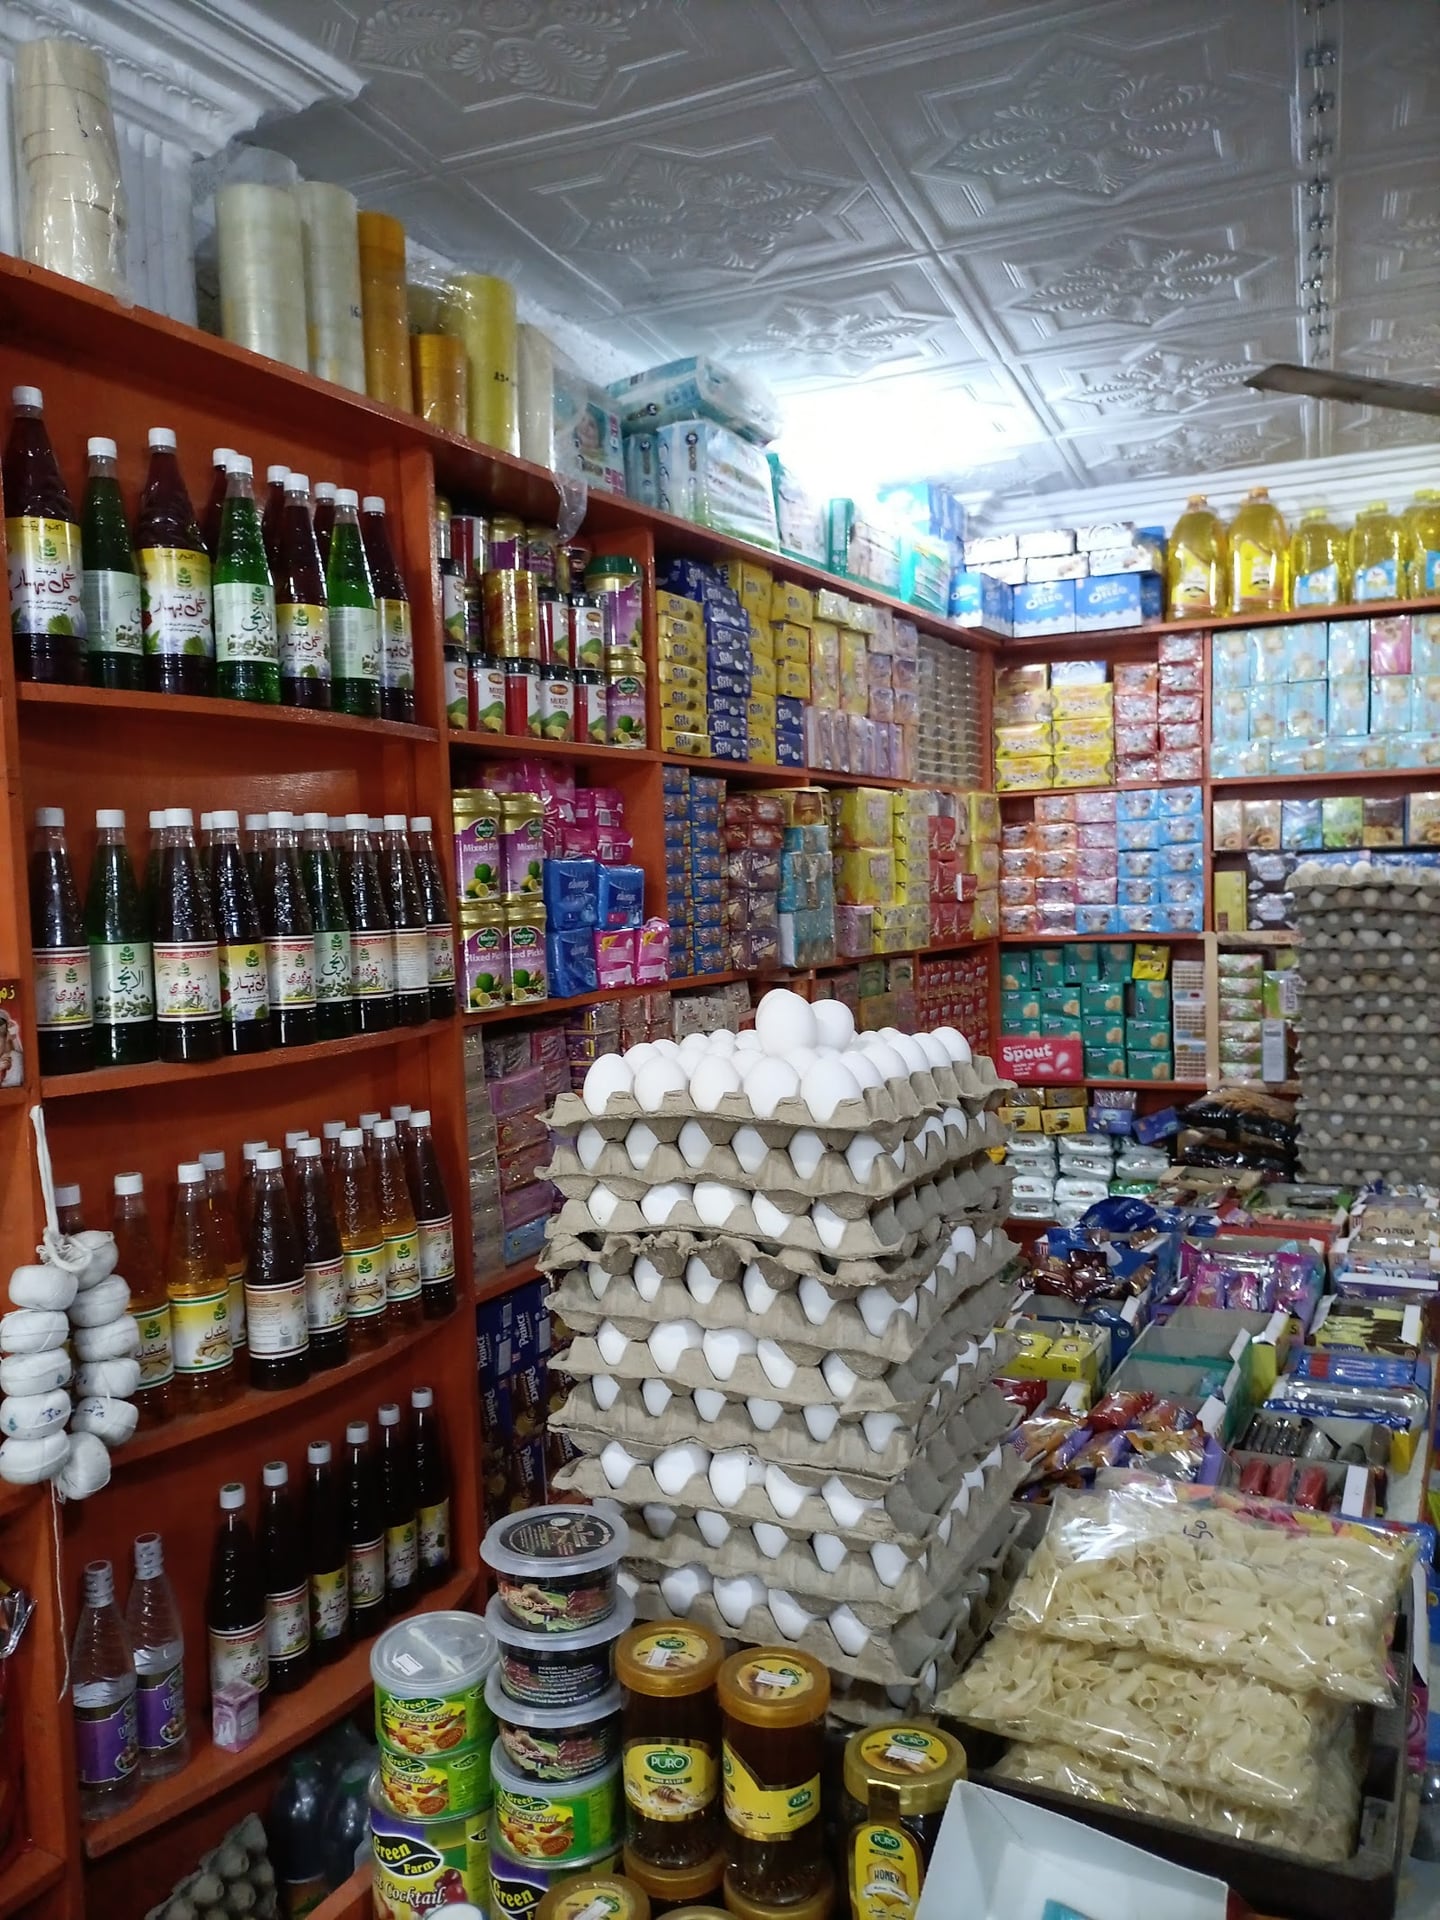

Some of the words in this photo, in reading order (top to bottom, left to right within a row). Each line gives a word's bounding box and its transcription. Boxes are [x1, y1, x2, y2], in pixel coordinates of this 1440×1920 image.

[15, 568, 46, 595] بہار
[48, 565, 76, 594] گل
[184, 592, 207, 617] گل
[463, 844, 487, 853] Mixed
[107, 966, 144, 995] الائچی
[1002, 1043, 1054, 1062] Spout
[397, 1698, 428, 1710] Green
[651, 1755, 685, 1769] PURO
[506, 1792, 534, 1805] Green
[874, 1833, 897, 1847] PURO
[373, 1836, 411, 1864] Green
[403, 1860, 436, 1876] Farm
[874, 1869, 900, 1884] HONEY
[385, 1880, 447, 1908] Cocktail
[493, 1880, 534, 1907] Green
